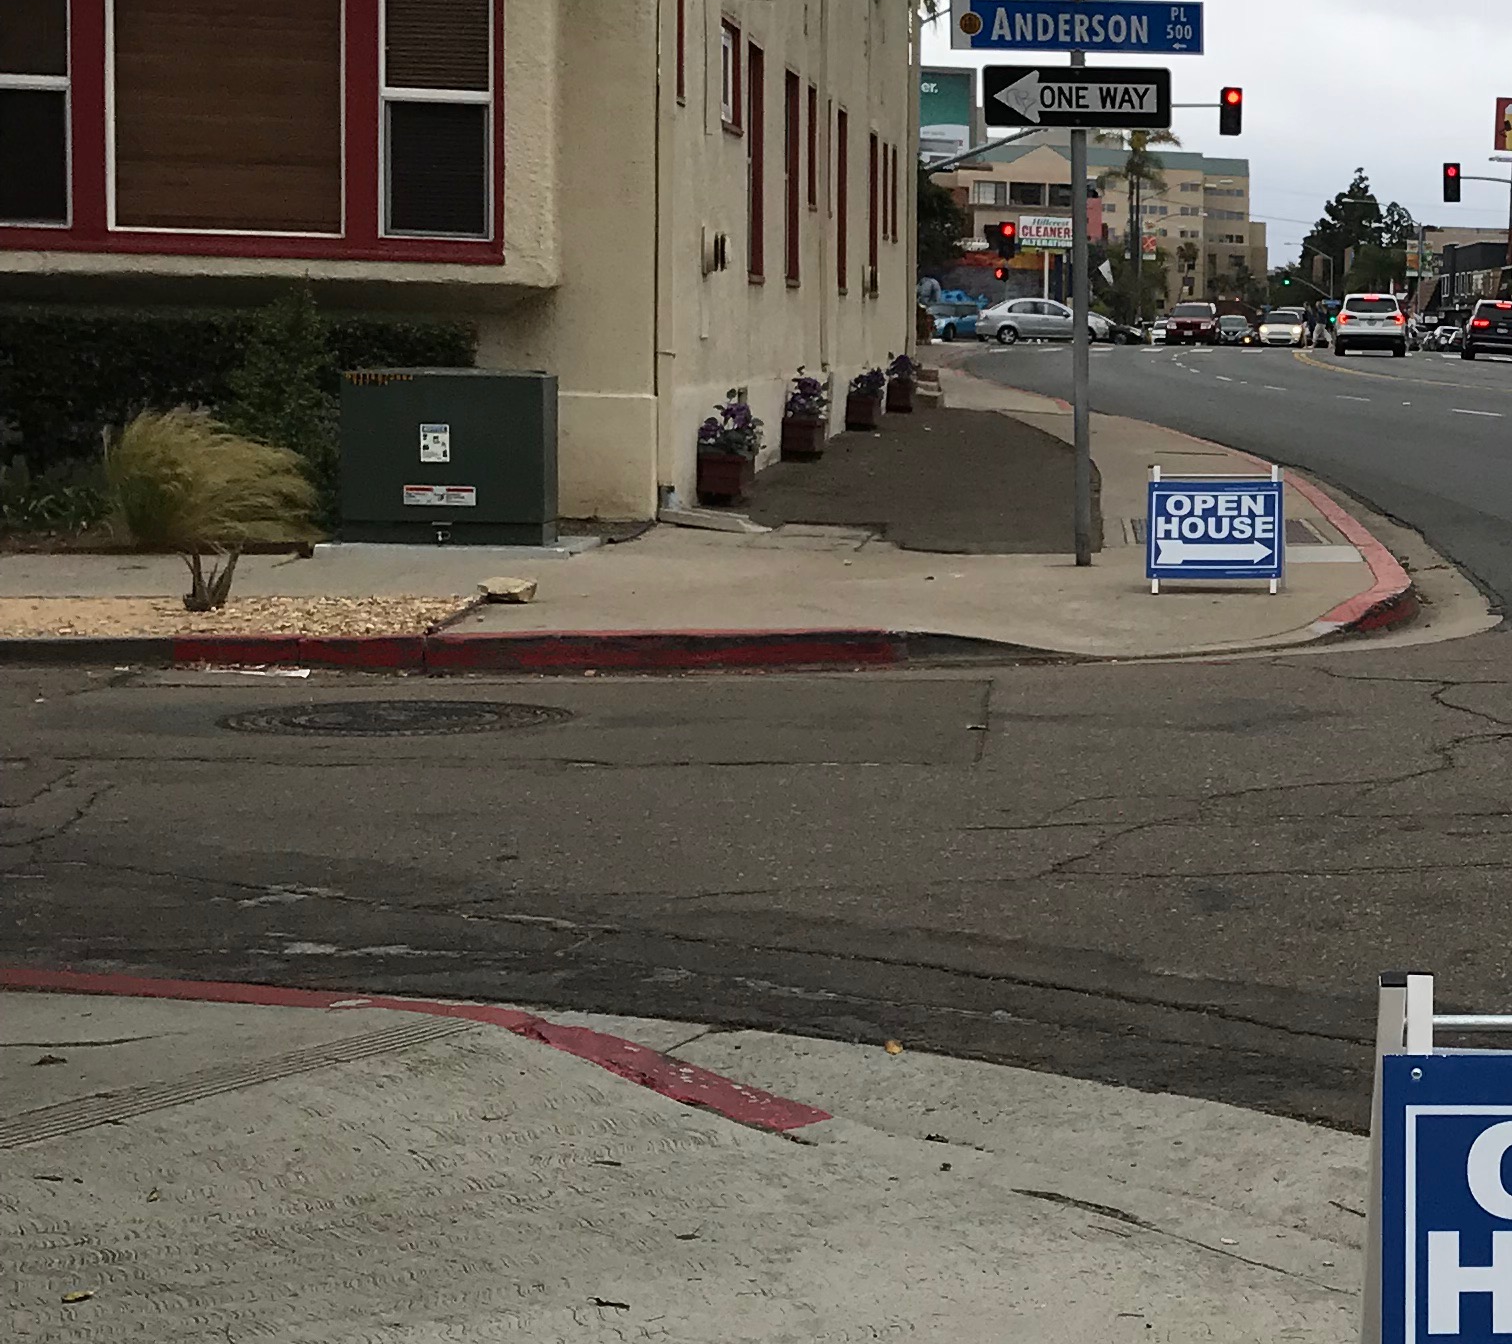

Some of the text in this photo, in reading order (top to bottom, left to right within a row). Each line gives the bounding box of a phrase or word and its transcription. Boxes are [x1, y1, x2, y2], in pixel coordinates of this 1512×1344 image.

[1170, 7, 1187, 22] PL
[991, 7, 1149, 44] ANDERSON
[1166, 24, 1192, 40] 500
[1040, 85, 1089, 109] ONE
[1099, 87, 1150, 110] WAY
[1022, 225, 1072, 238] CLEANER
[1166, 495, 1264, 516] OPEN
[1156, 517, 1274, 538] HOUSE
